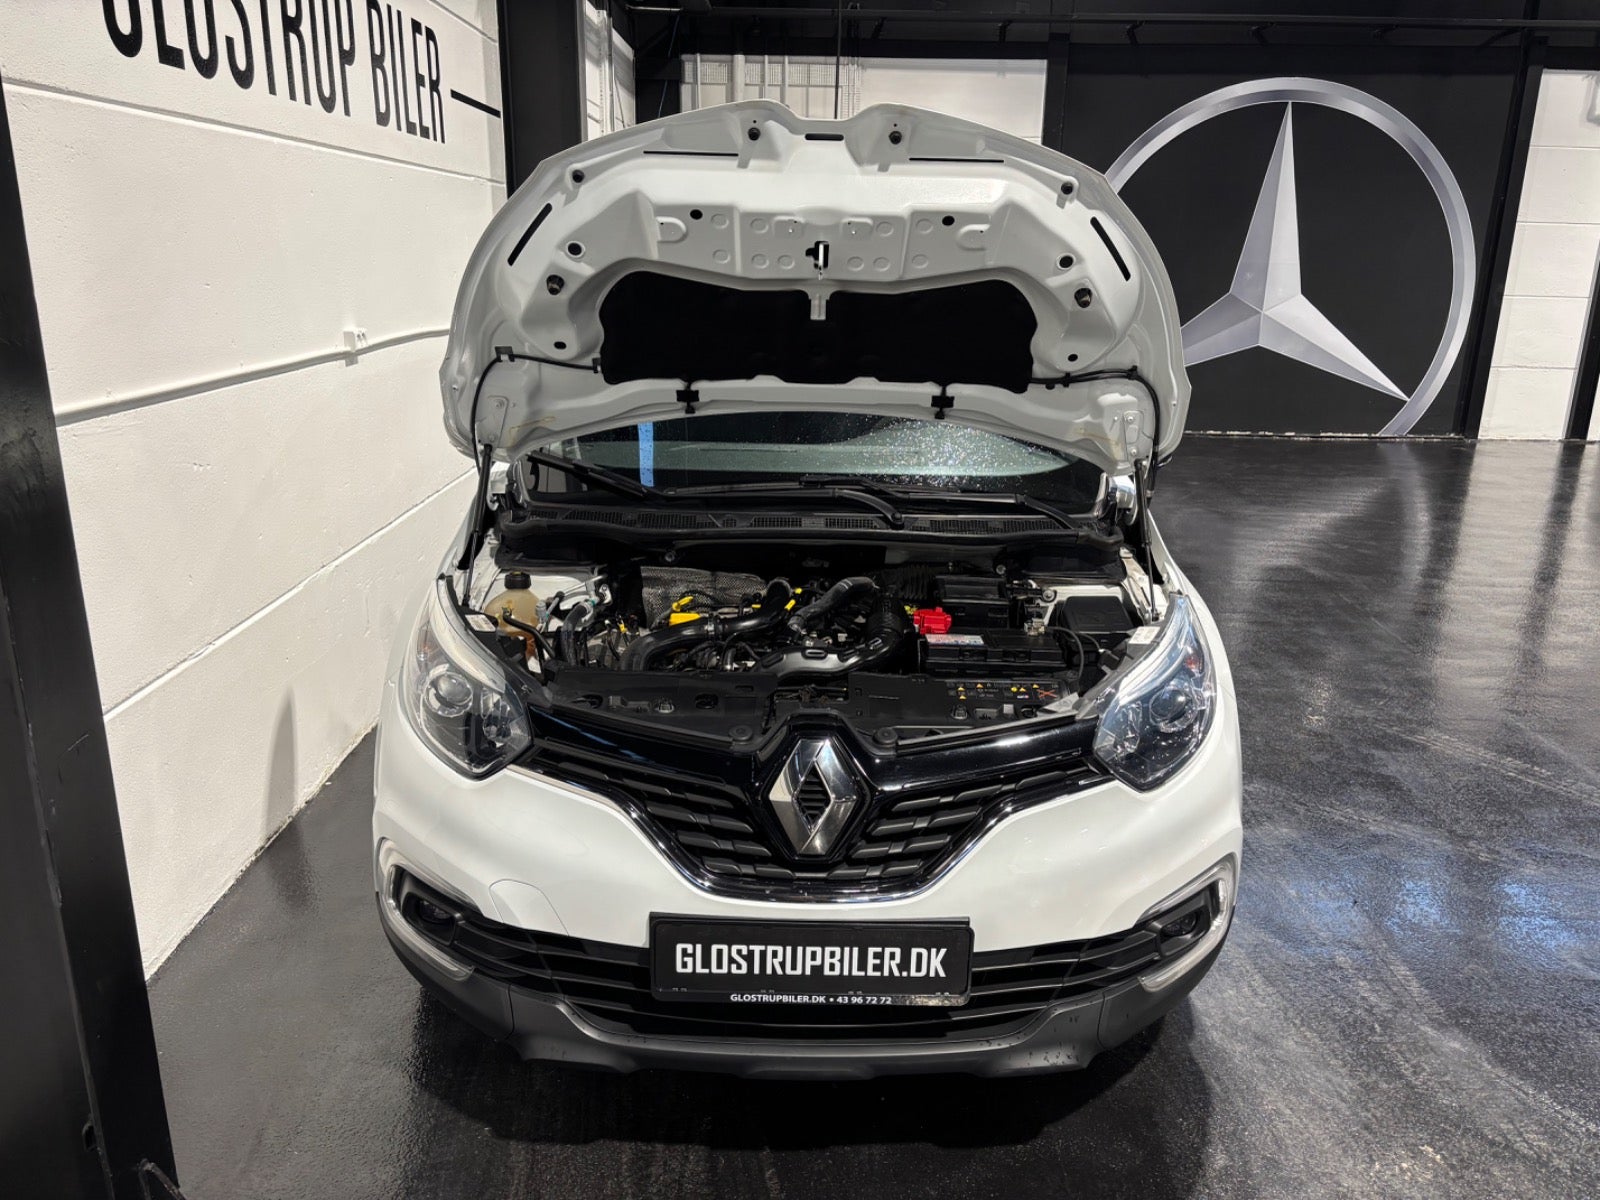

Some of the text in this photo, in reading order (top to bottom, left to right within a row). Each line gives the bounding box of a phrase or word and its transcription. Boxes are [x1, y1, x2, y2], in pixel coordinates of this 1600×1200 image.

[366, 0, 446, 144] BILER
[675, 942, 948, 978] GLOSTRUPBILER.DK
[730, 993, 892, 1005] GLOSTRUPBILER.DK 43 96 72 72
